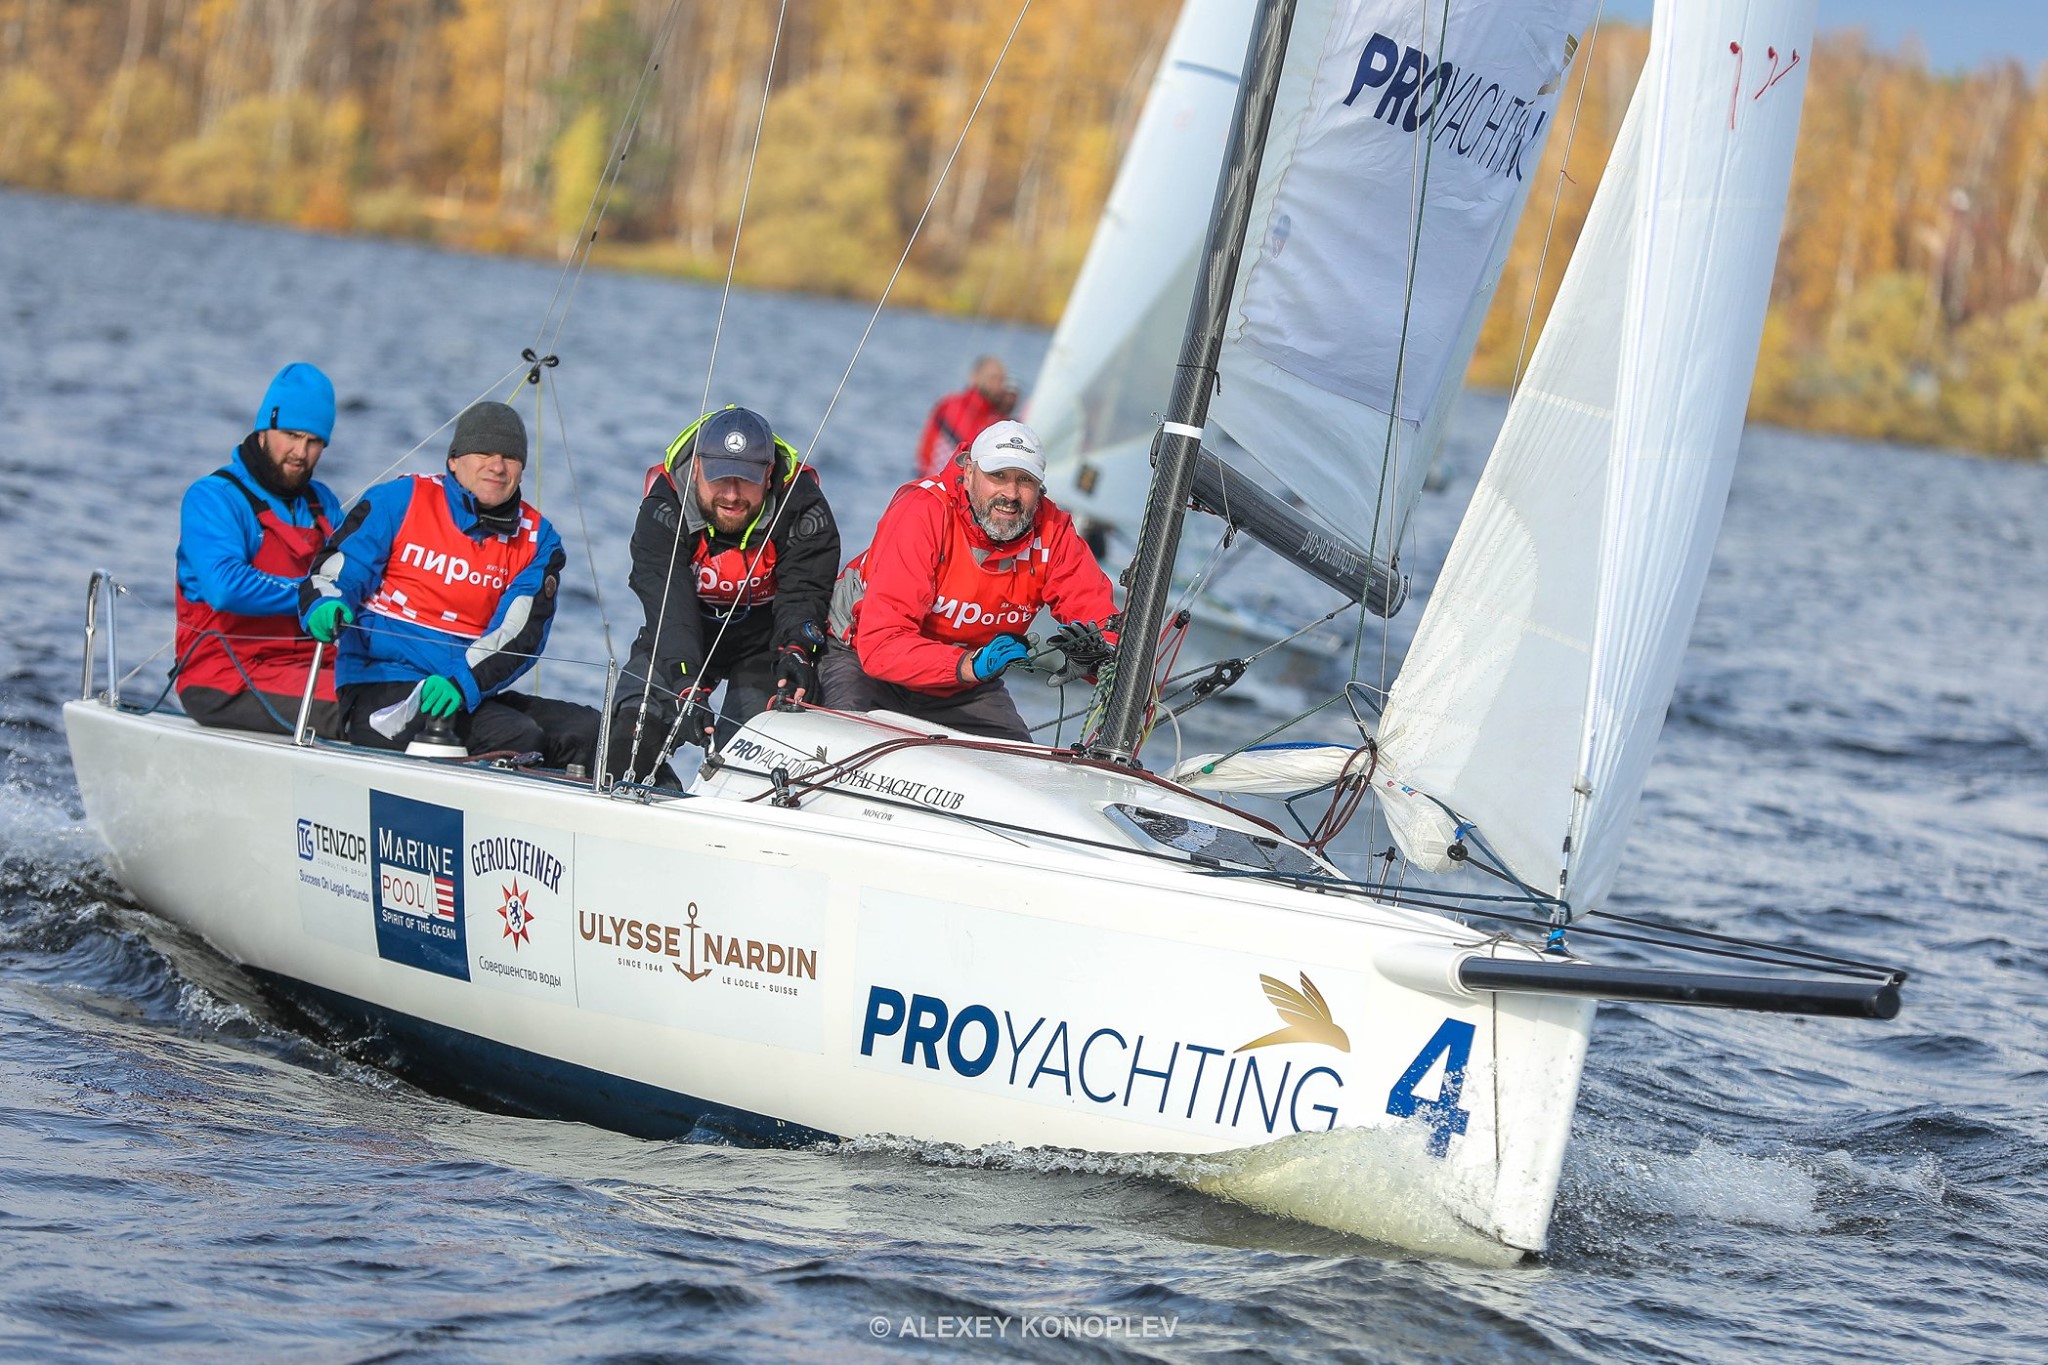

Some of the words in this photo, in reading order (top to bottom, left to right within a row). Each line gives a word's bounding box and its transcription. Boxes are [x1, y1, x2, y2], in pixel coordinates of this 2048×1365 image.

[400, 543, 512, 590] пирого
[875, 776, 925, 801] YACHT
[923, 791, 965, 810] CLUB
[862, 807, 895, 822] MOSCOW
[314, 823, 367, 864] TENZOR
[379, 827, 454, 876] MARINE
[471, 837, 563, 895] GEROLSTEINER
[299, 869, 321, 888] Success
[321, 877, 329, 890] On
[330, 879, 345, 897] Legal
[345, 884, 369, 903] Grounds
[382, 874, 425, 908] POOL
[381, 909, 404, 926] SPIRIT
[405, 916, 415, 929] OF
[417, 920, 431, 934] THE
[432, 924, 457, 940] OCEAN
[579, 910, 681, 958] ULYSSE
[703, 932, 818, 981] NARDIN
[478, 955, 538, 983] Совершенство
[539, 974, 562, 989] воды
[617, 957, 642, 970] SINCE
[645, 963, 664, 973] 1846
[722, 976, 732, 985] LE
[734, 978, 760, 990] LOCLE
[769, 984, 799, 997] SUISSE
[860, 985, 1344, 1134] PROYACHTING
[1385, 1017, 1477, 1158] 4
